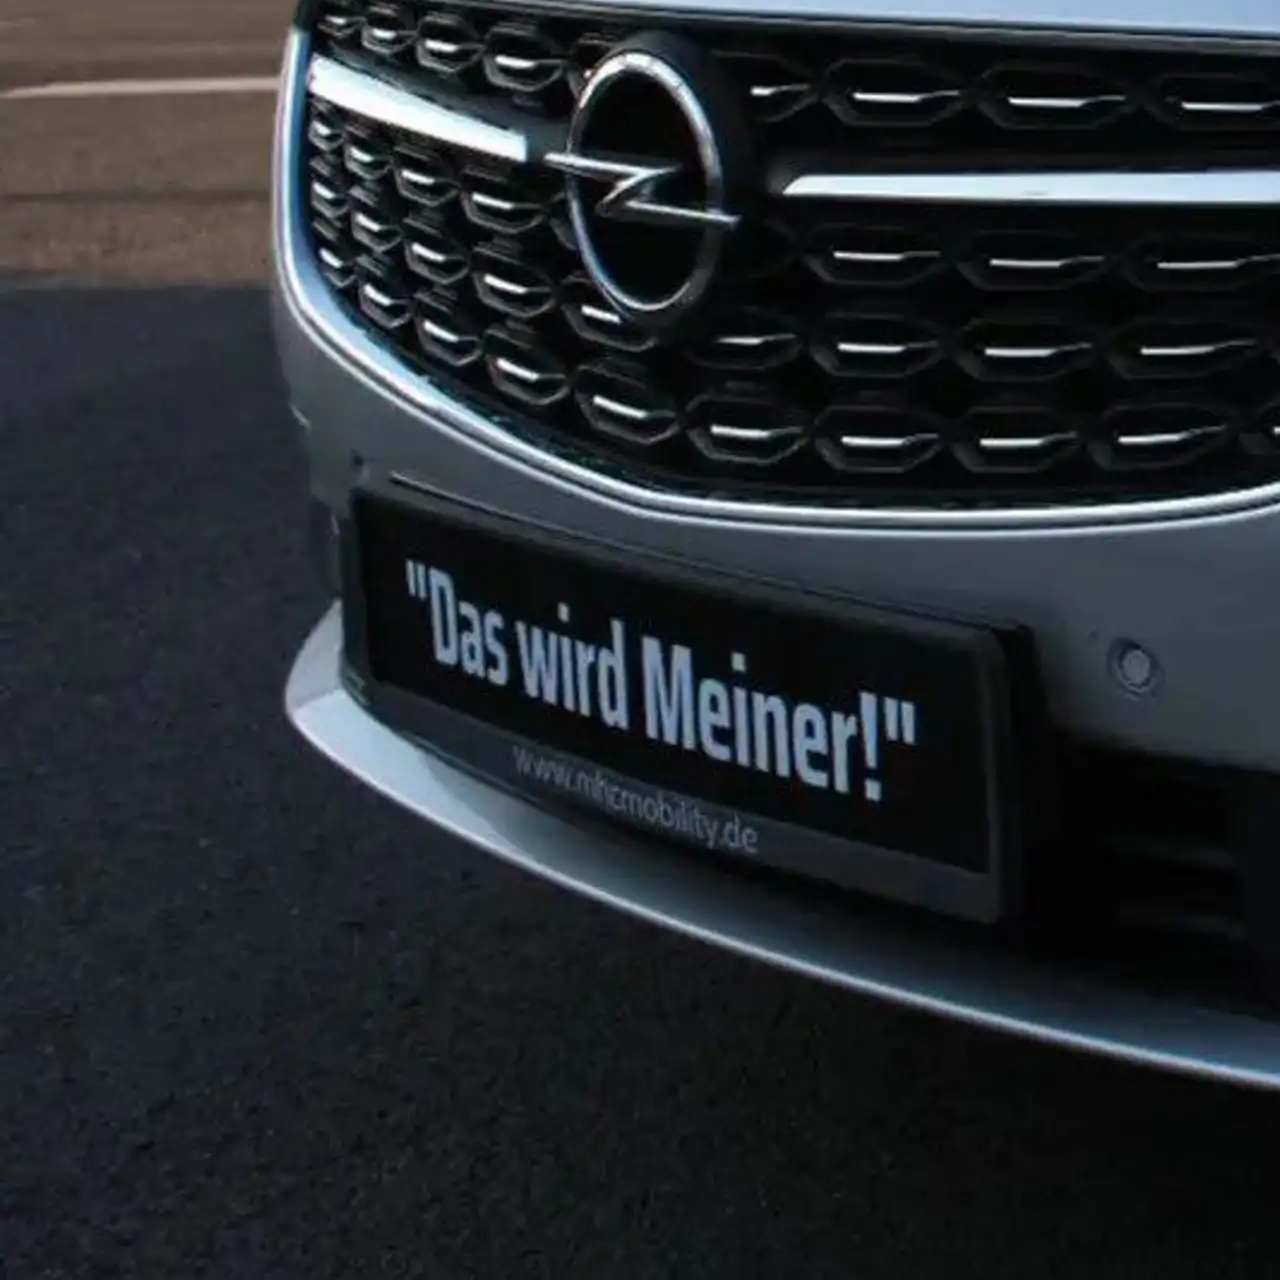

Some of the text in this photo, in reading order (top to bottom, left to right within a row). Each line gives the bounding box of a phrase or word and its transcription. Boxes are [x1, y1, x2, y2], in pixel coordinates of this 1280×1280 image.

[406, 559, 916, 803] "Das wird Meiner!"
